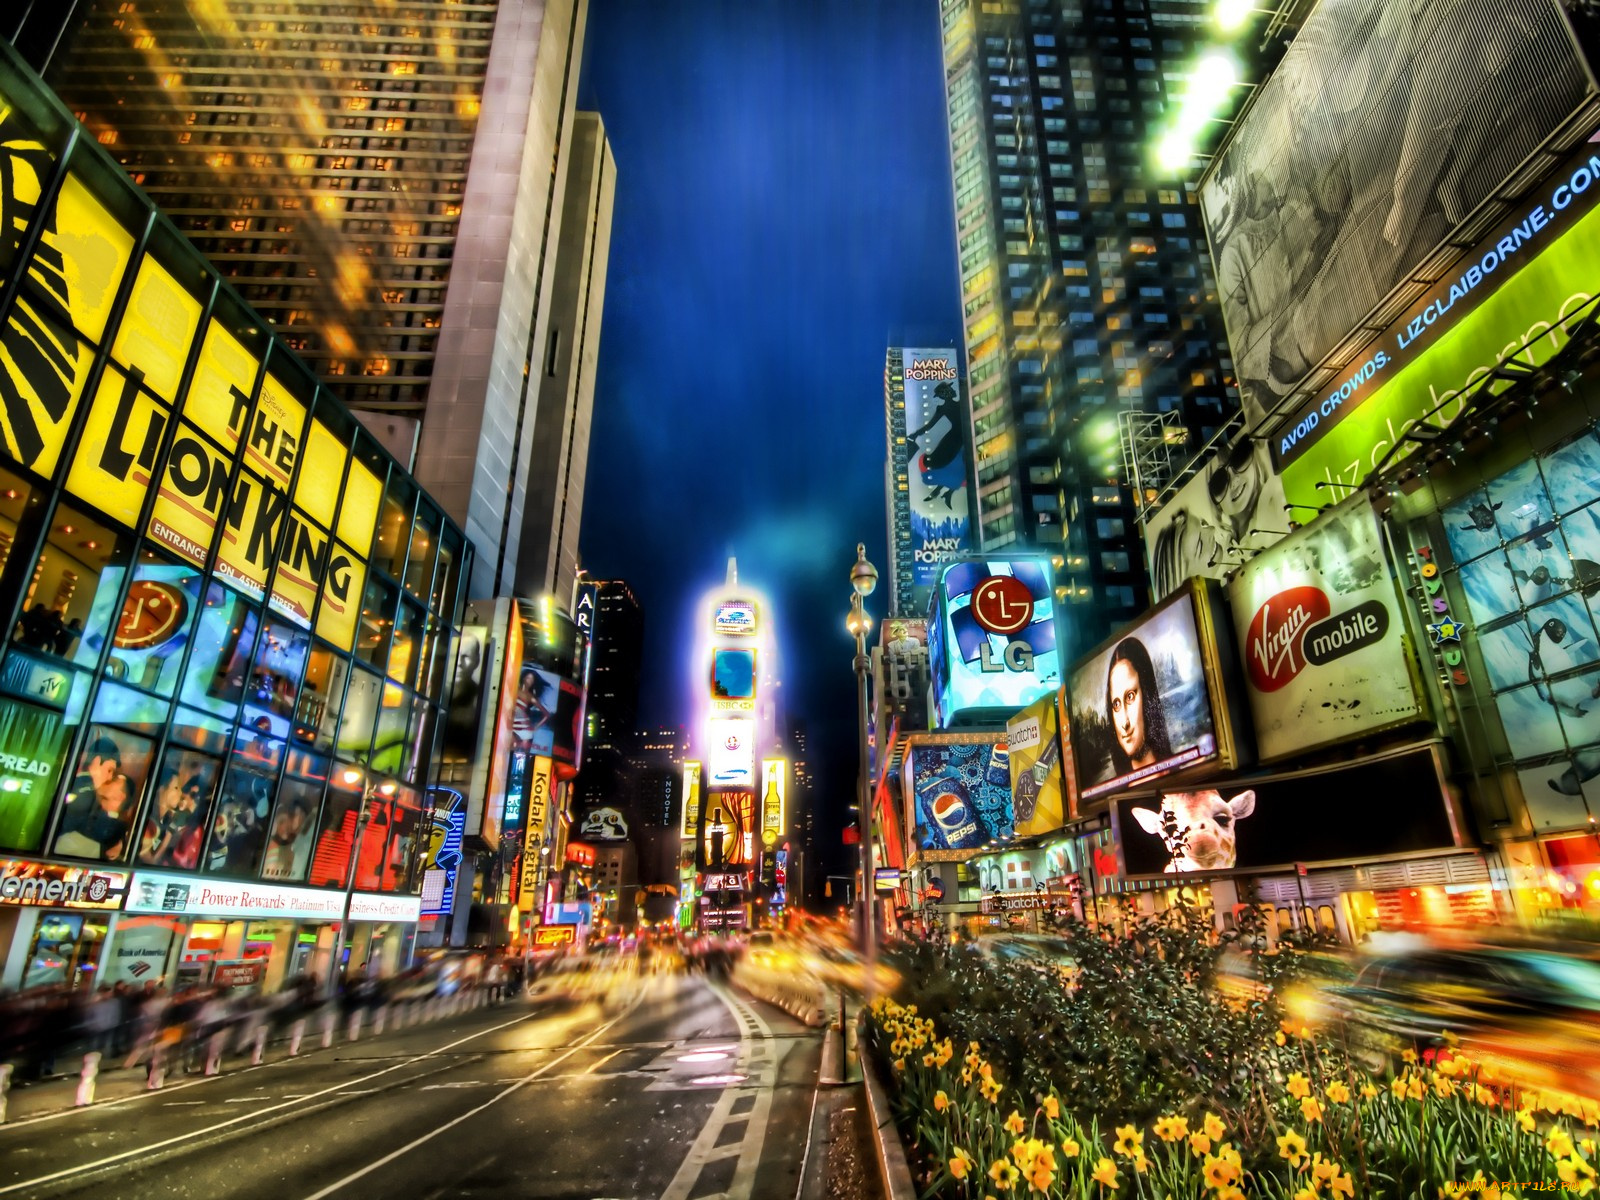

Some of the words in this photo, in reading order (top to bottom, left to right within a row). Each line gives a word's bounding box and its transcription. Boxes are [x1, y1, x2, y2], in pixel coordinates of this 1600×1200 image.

[905, 368, 956, 380] POPPINS
[914, 359, 947, 369] MARY
[1281, 412, 1319, 454] AVOID
[1320, 350, 1391, 417] CROWDS.
[227, 384, 296, 474] THE
[99, 364, 251, 531] LION
[245, 475, 352, 603] KING
[923, 538, 960, 550] MARY
[153, 522, 207, 561] ENTRANCE
[219, 562, 234, 577] ON
[239, 574, 261, 593] 45TH
[270, 594, 296, 612] STREET
[578, 593, 593, 635] AR
[1417, 546, 1447, 613] TOYS
[1446, 650, 1468, 686] US
[980, 640, 1035, 673] LG
[1254, 603, 1311, 679] Virgin
[1312, 612, 1379, 657] mobile
[1007, 725, 1032, 747] swatch
[989, 761, 1009, 770] PEPSI
[530, 772, 547, 828] Kodak
[946, 822, 977, 845] PEPSI
[200, 888, 238, 906] Power
[240, 891, 285, 909] Rewards
[290, 898, 324, 912] Platinum
[350, 901, 377, 913] usiness
[117, 948, 133, 957] Bank
[134, 948, 142, 957] of
[142, 948, 166, 957] America
